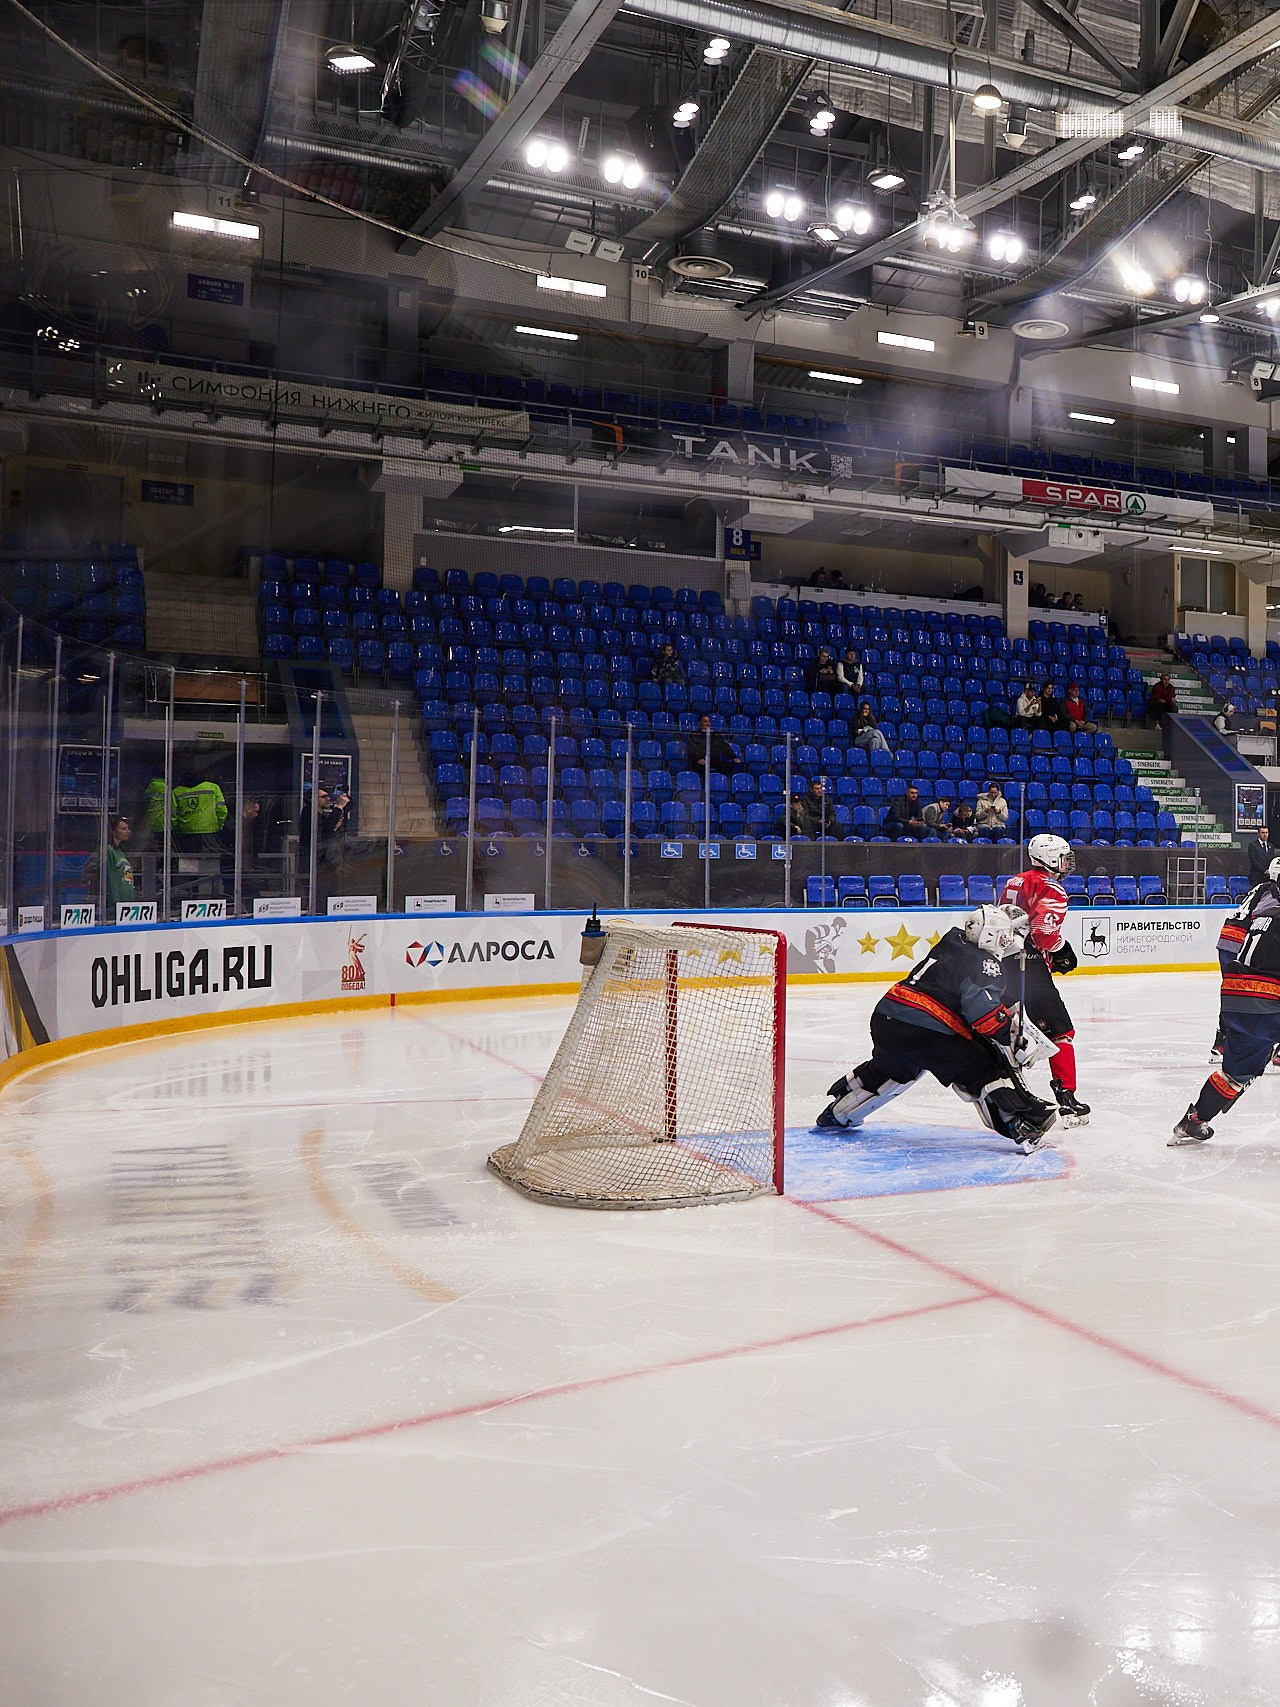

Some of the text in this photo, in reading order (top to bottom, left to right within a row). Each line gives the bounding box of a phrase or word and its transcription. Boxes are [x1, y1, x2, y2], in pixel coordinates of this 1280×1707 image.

[219, 196, 231, 207] 11
[635, 269, 647, 278] 10
[978, 326, 985, 335] 9
[1253, 378, 1259, 386] 8
[172, 376, 507, 428] СИМФОНИЯ НИЖНЕГО ЖИЛОЙ КОМПЛЕКС
[671, 434, 819, 475] TANK
[1046, 486, 1121, 509] SPAR
[732, 528, 743, 546] 8
[63, 908, 93, 925] PARI
[119, 905, 154, 921] PARI
[185, 903, 223, 919] PARI
[1116, 920, 1201, 932] ПРАВИТЕЛЬСТВО
[1116, 933, 1193, 943] НИЖЕГОРОДСКОЙ
[447, 939, 556, 963] АЛРОСА
[1116, 944, 1158, 953] ОБЛАСТИ
[91, 944, 273, 1008] OHLIGA.RU
[341, 965, 356, 980] 80
[341, 982, 366, 991] ПОБЕДА!
